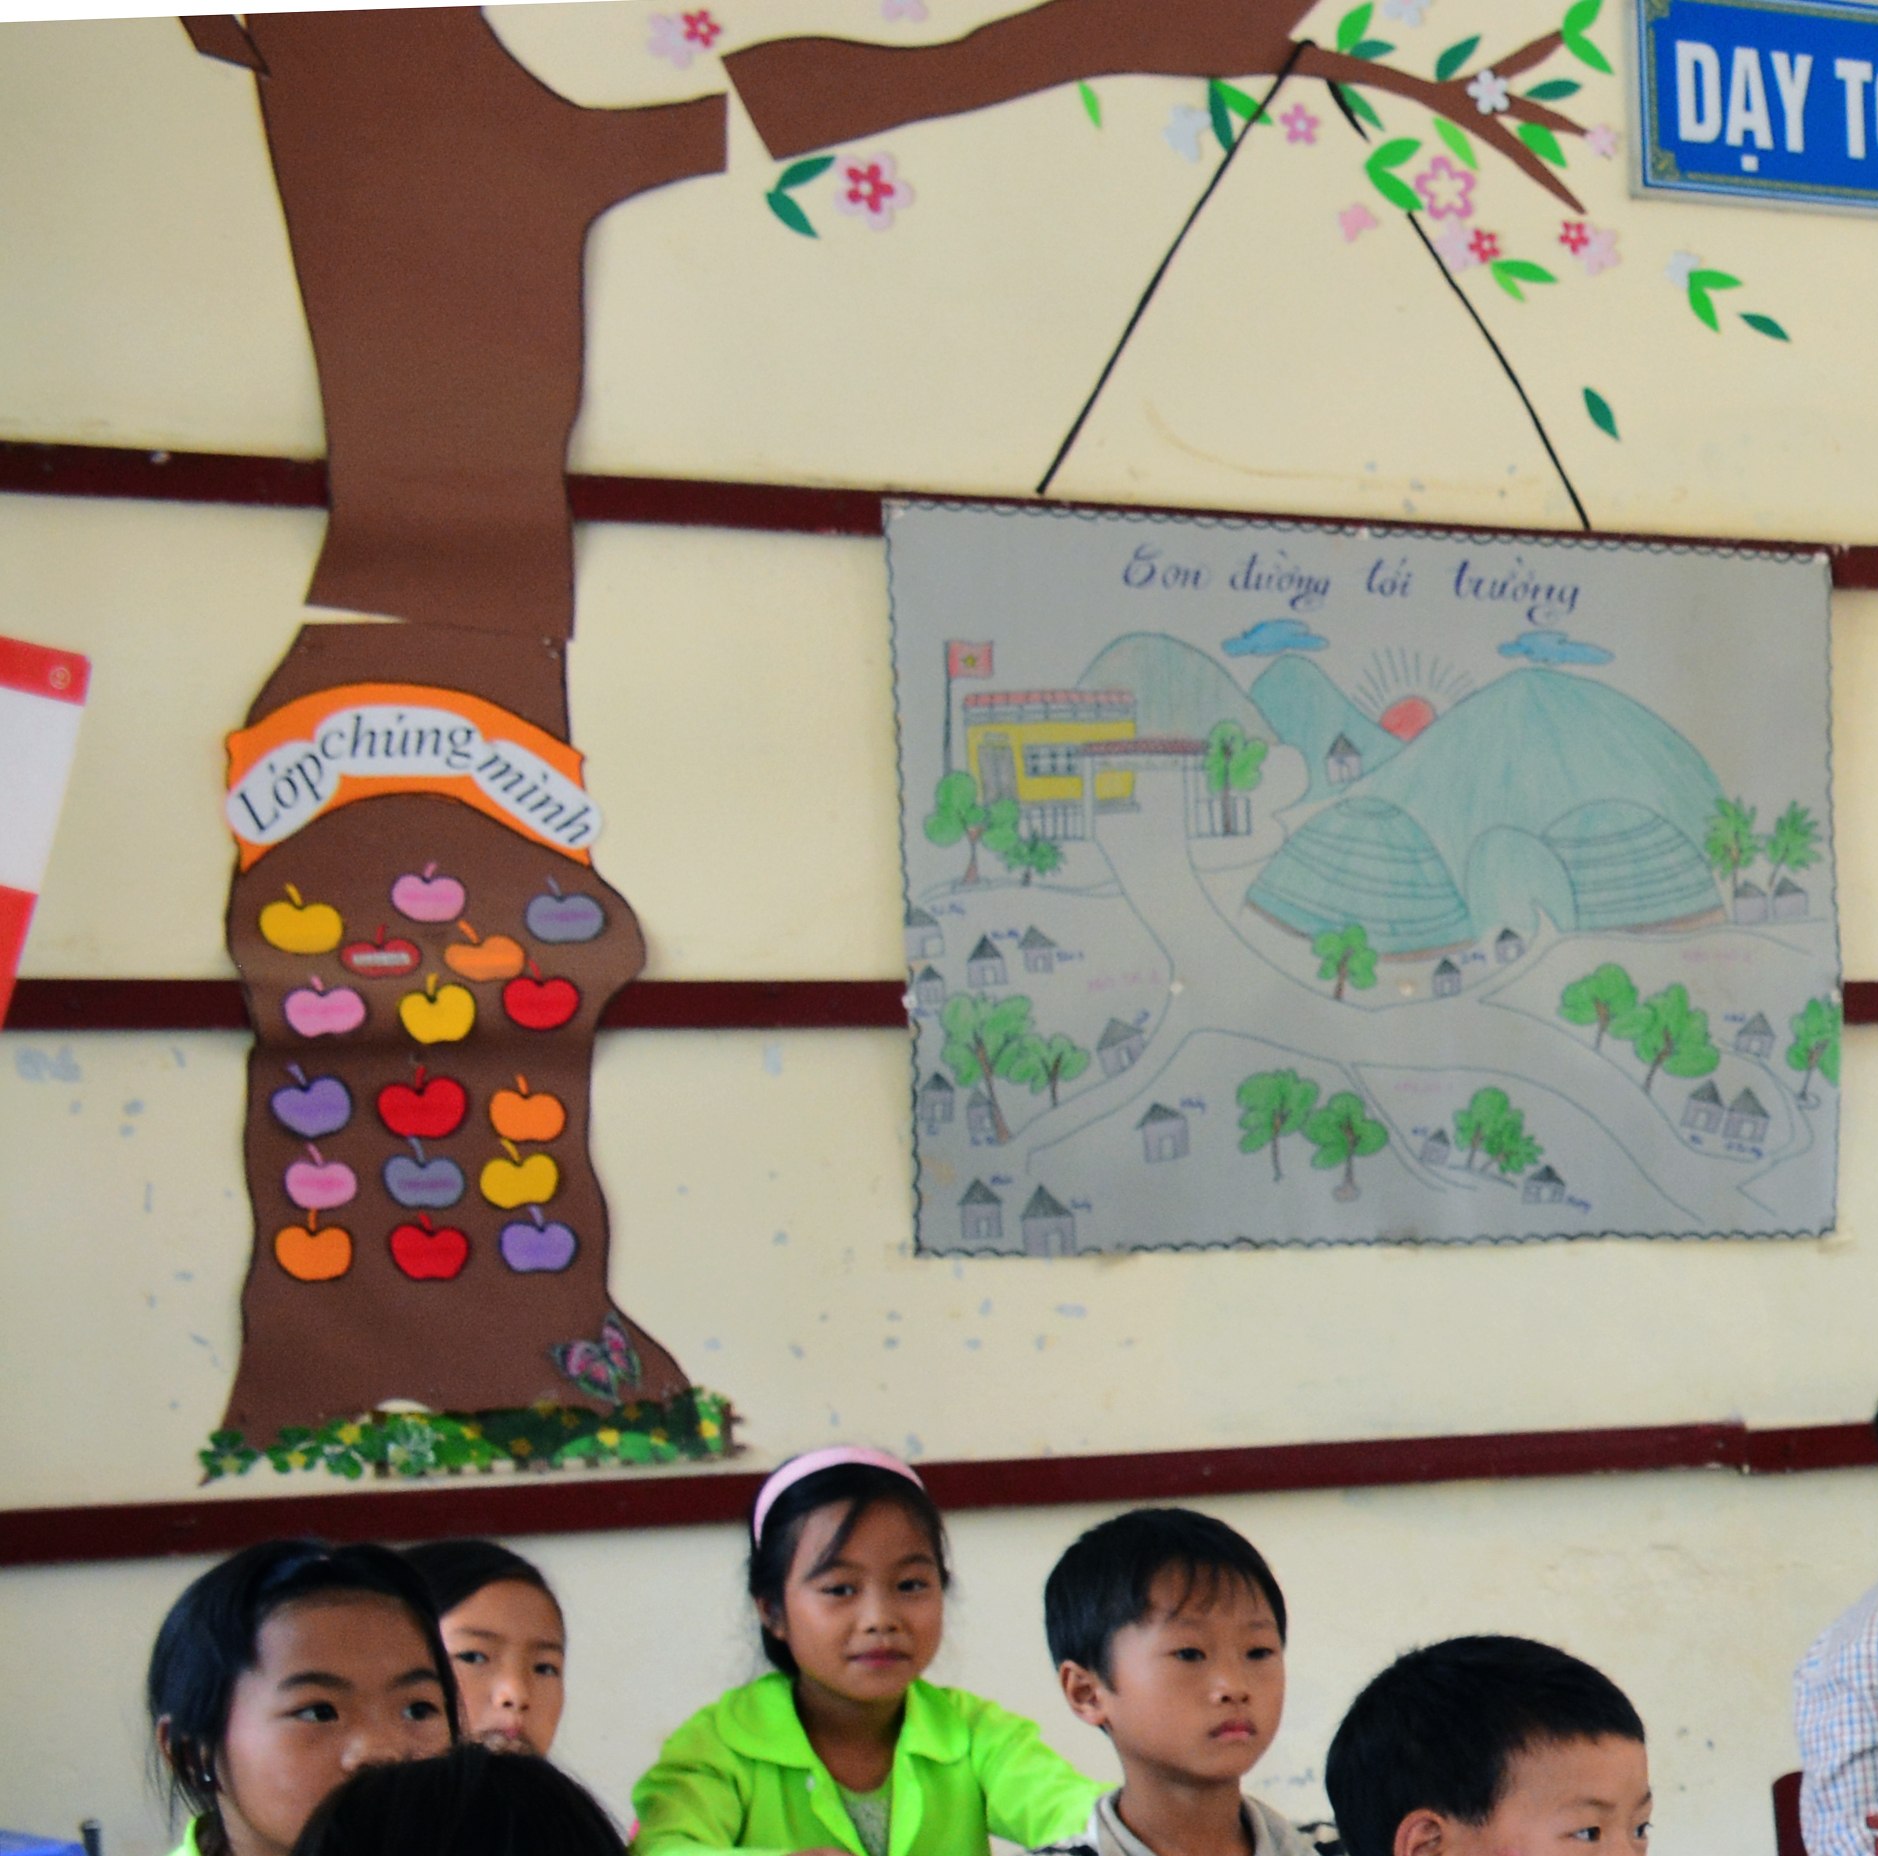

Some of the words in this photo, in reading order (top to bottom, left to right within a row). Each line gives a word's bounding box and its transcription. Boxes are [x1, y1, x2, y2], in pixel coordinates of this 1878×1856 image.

[1674, 40, 1812, 172] DẠY
[239, 754, 324, 834] Lớp
[320, 713, 476, 770] chúng
[477, 752, 592, 846] mình
